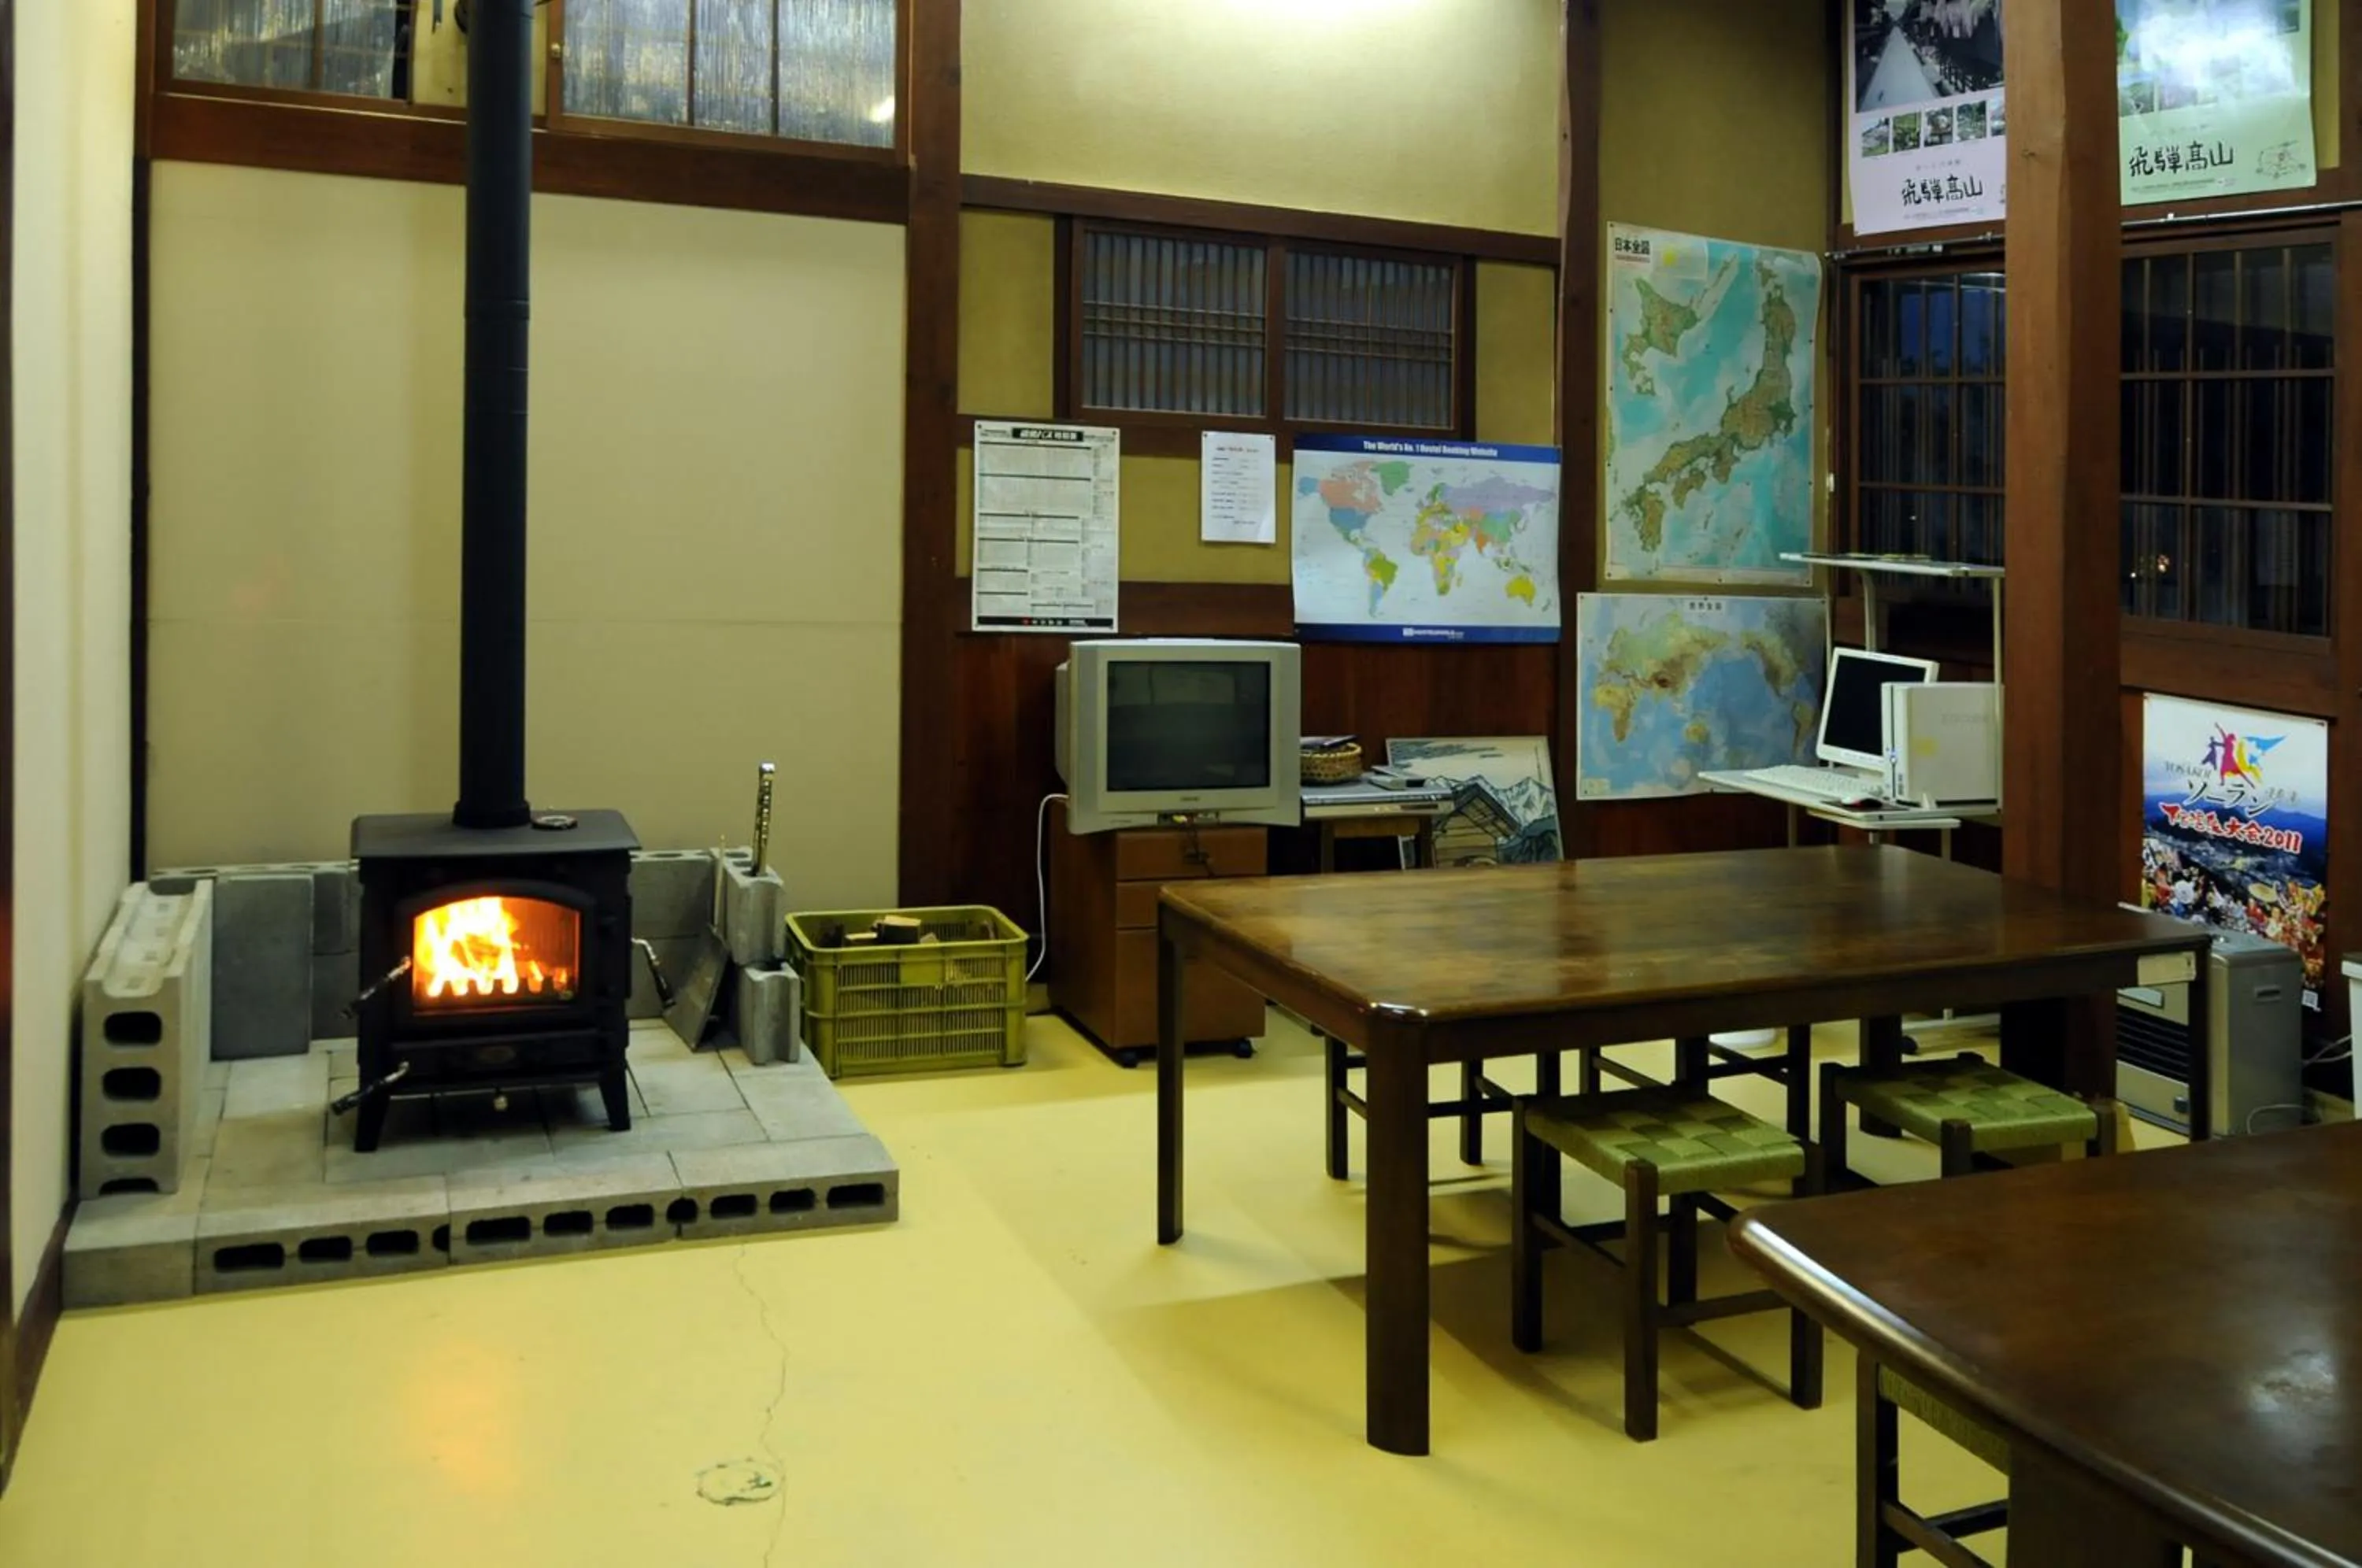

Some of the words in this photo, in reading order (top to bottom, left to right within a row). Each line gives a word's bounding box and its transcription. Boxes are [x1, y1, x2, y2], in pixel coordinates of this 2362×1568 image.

[1363, 440, 1376, 449] The
[2183, 779, 2274, 817] ソーラン
